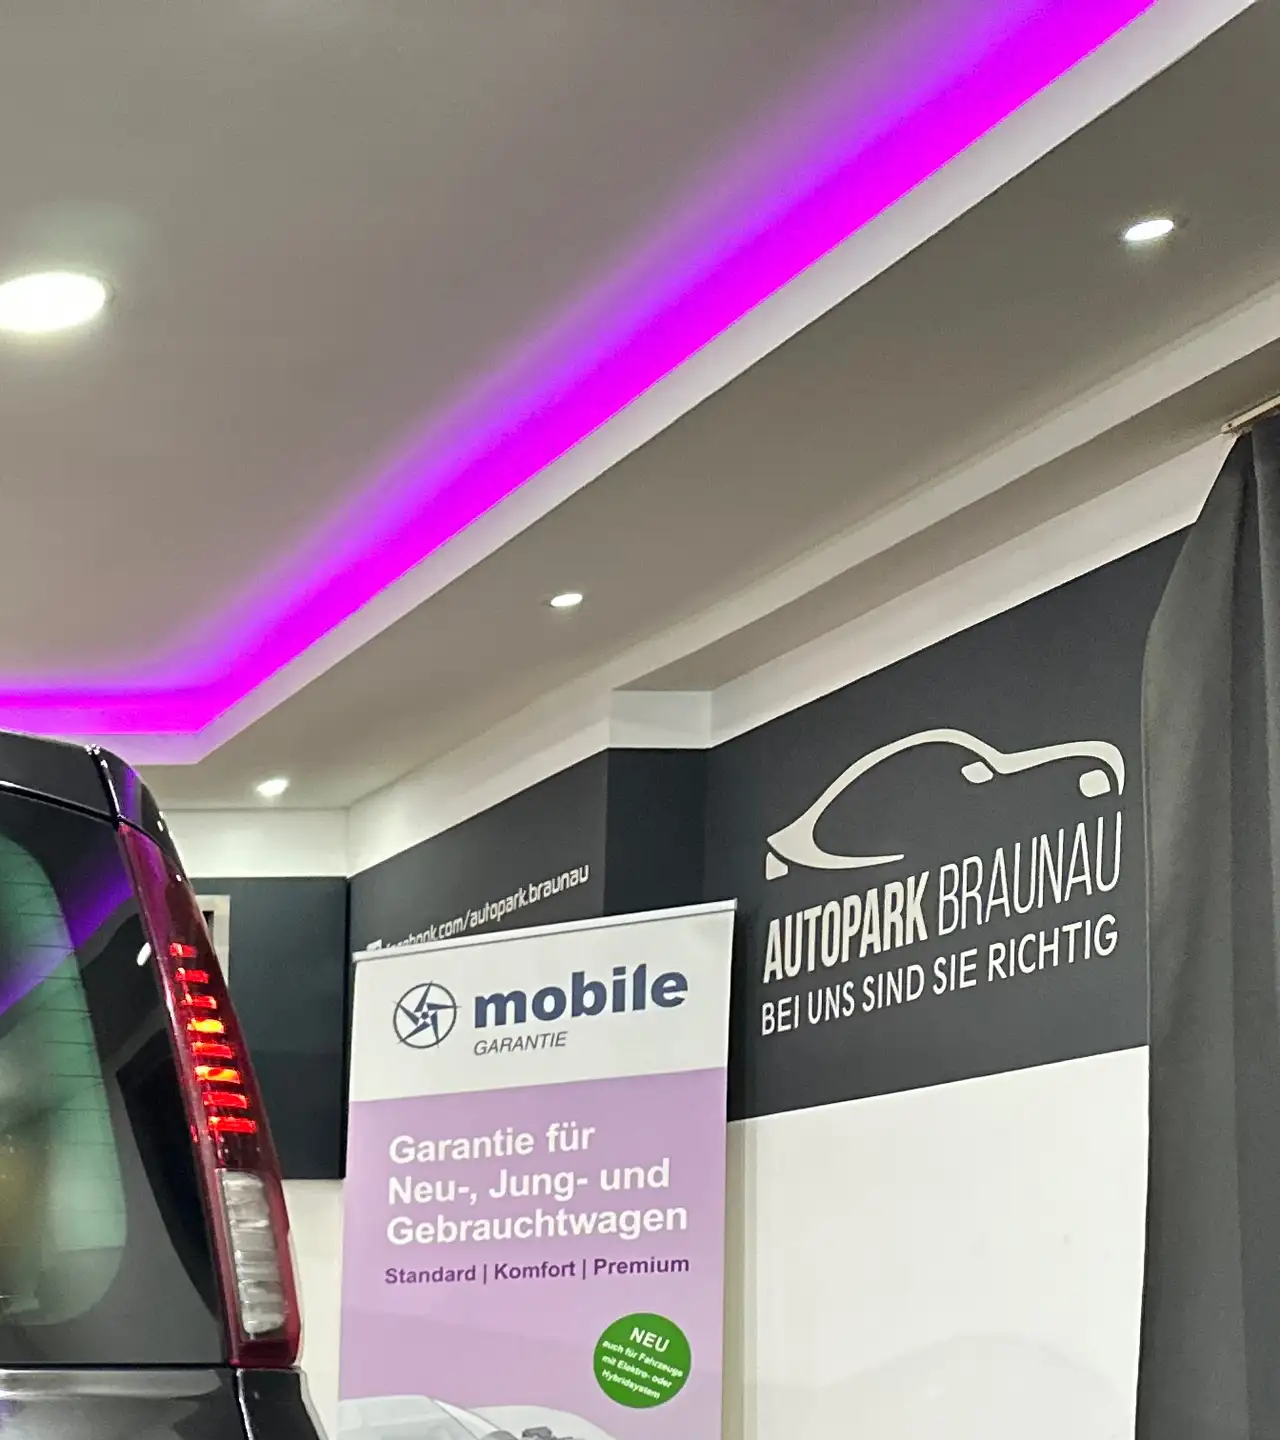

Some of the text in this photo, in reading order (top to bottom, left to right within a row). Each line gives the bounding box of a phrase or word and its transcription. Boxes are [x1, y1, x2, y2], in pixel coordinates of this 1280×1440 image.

[763, 811, 1122, 983] AUTOPARK BRAUNAU
[762, 913, 1118, 1036] BEI UNS SIND SIE RICHTIG
[474, 963, 688, 1028] mobile
[473, 1030, 568, 1056] GARANTIE
[388, 1121, 596, 1164] Garantie für
[388, 1157, 670, 1206] Neu-, Jung- und
[386, 1206, 688, 1246] Gebrauchtwagen
[384, 1264, 476, 1285] Standard
[494, 1260, 576, 1280] Komfort
[593, 1255, 690, 1276] Premium
[624, 1347, 639, 1359] für
[629, 1326, 671, 1353] NEU
